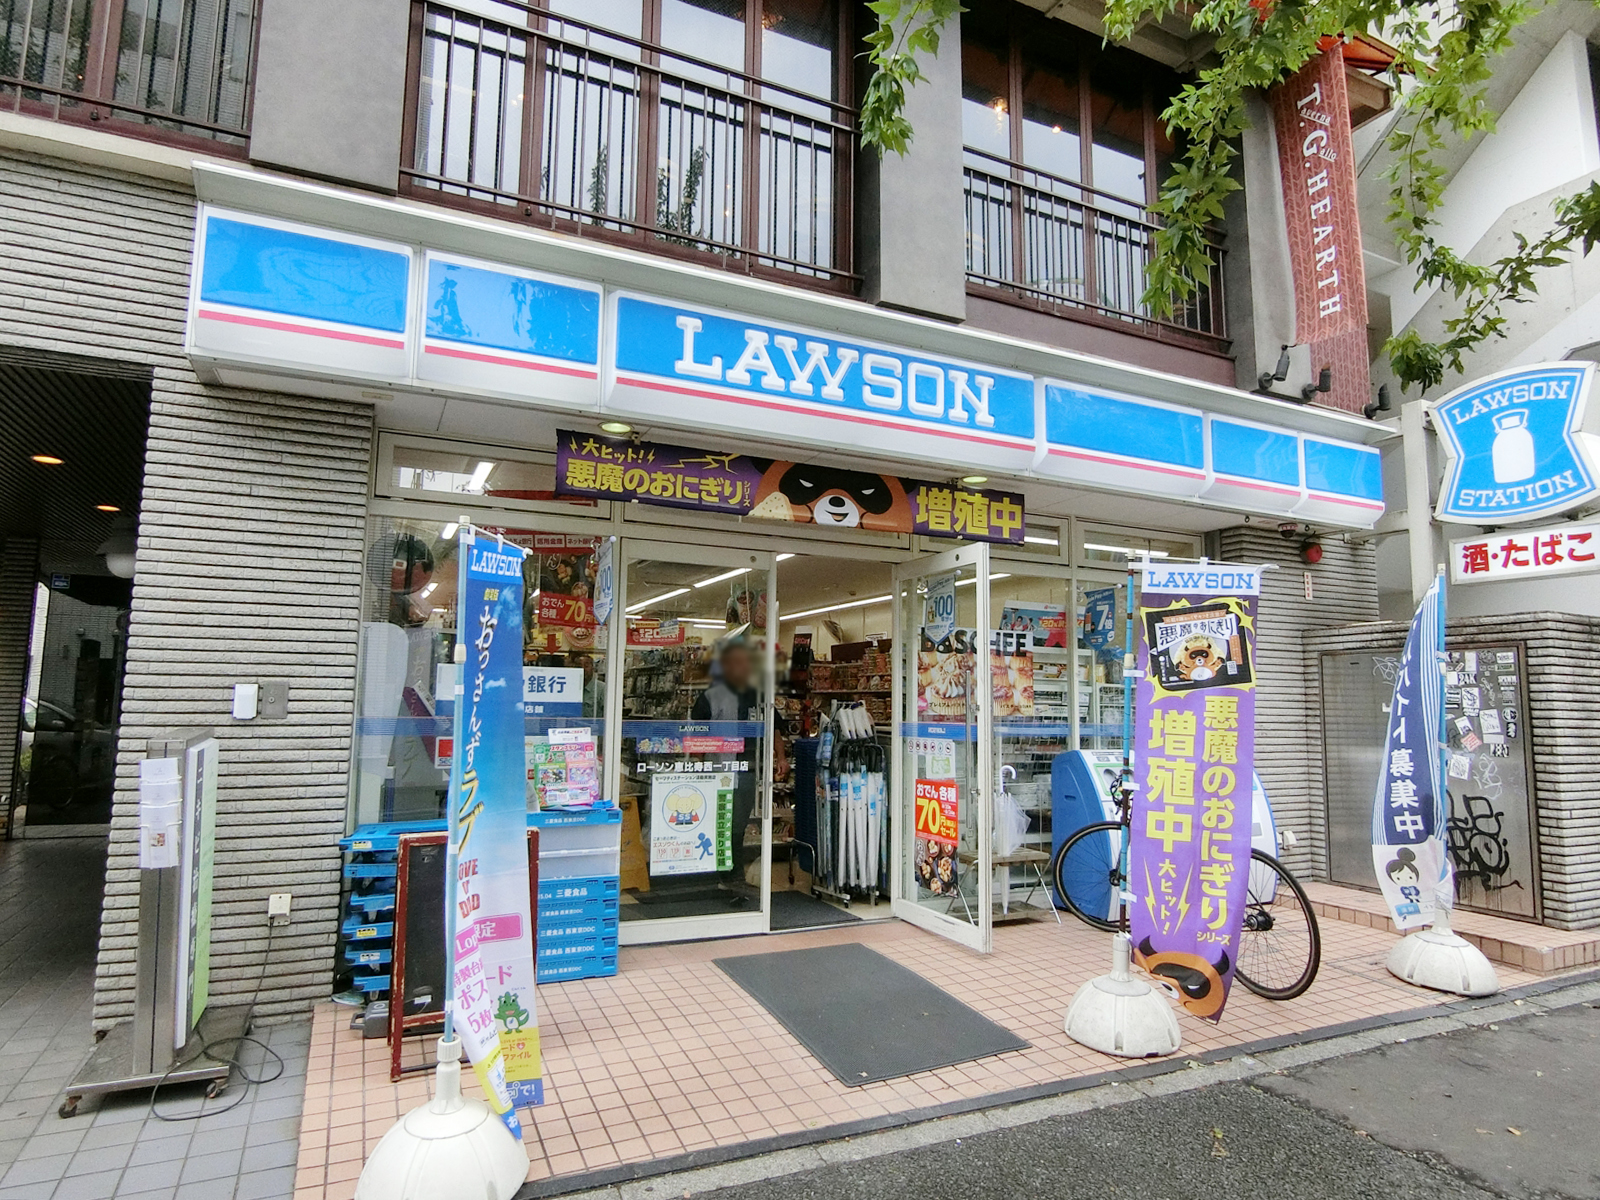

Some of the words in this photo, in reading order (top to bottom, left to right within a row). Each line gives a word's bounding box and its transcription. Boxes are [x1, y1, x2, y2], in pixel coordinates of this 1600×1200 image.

[675, 316, 996, 428] LAWSON
[1452, 381, 1570, 425] LAWSON
[566, 458, 743, 505] 悪魔のおにぎり
[743, 480, 751, 507] シリーズ
[1459, 470, 1578, 507] STATION
[916, 486, 1023, 538] 増殖中
[471, 549, 522, 577] LAWSON
[1462, 532, 1596, 574] 酒・たばこ
[1148, 571, 1255, 589] LAWSON
[541, 597, 565, 608] おでん
[541, 608, 557, 618] 各種
[564, 599, 586, 622] 70
[1096, 605, 1109, 630] 7
[1159, 618, 1234, 646] 悪魔のおにぎり
[523, 674, 567, 694] 銀行
[457, 604, 498, 858] おっさんずラブ
[637, 761, 749, 773] ローソン恵比寿西一丁目店
[916, 783, 938, 799] おでん
[1146, 708, 1197, 853] 増殖中
[916, 797, 940, 834] 70
[1200, 695, 1239, 930] 悪魔のおにぎり
[940, 826, 956, 838] セール
[556, 887, 588, 898] 三菱食品
[540, 929, 564, 937] 三菱食品
[1196, 931, 1232, 946] シリーズ
[539, 948, 563, 957] 三菱食品
[466, 1009, 494, 1034] 5枚
[503, 1051, 532, 1062] ファイル
[520, 1084, 535, 1096] で!
